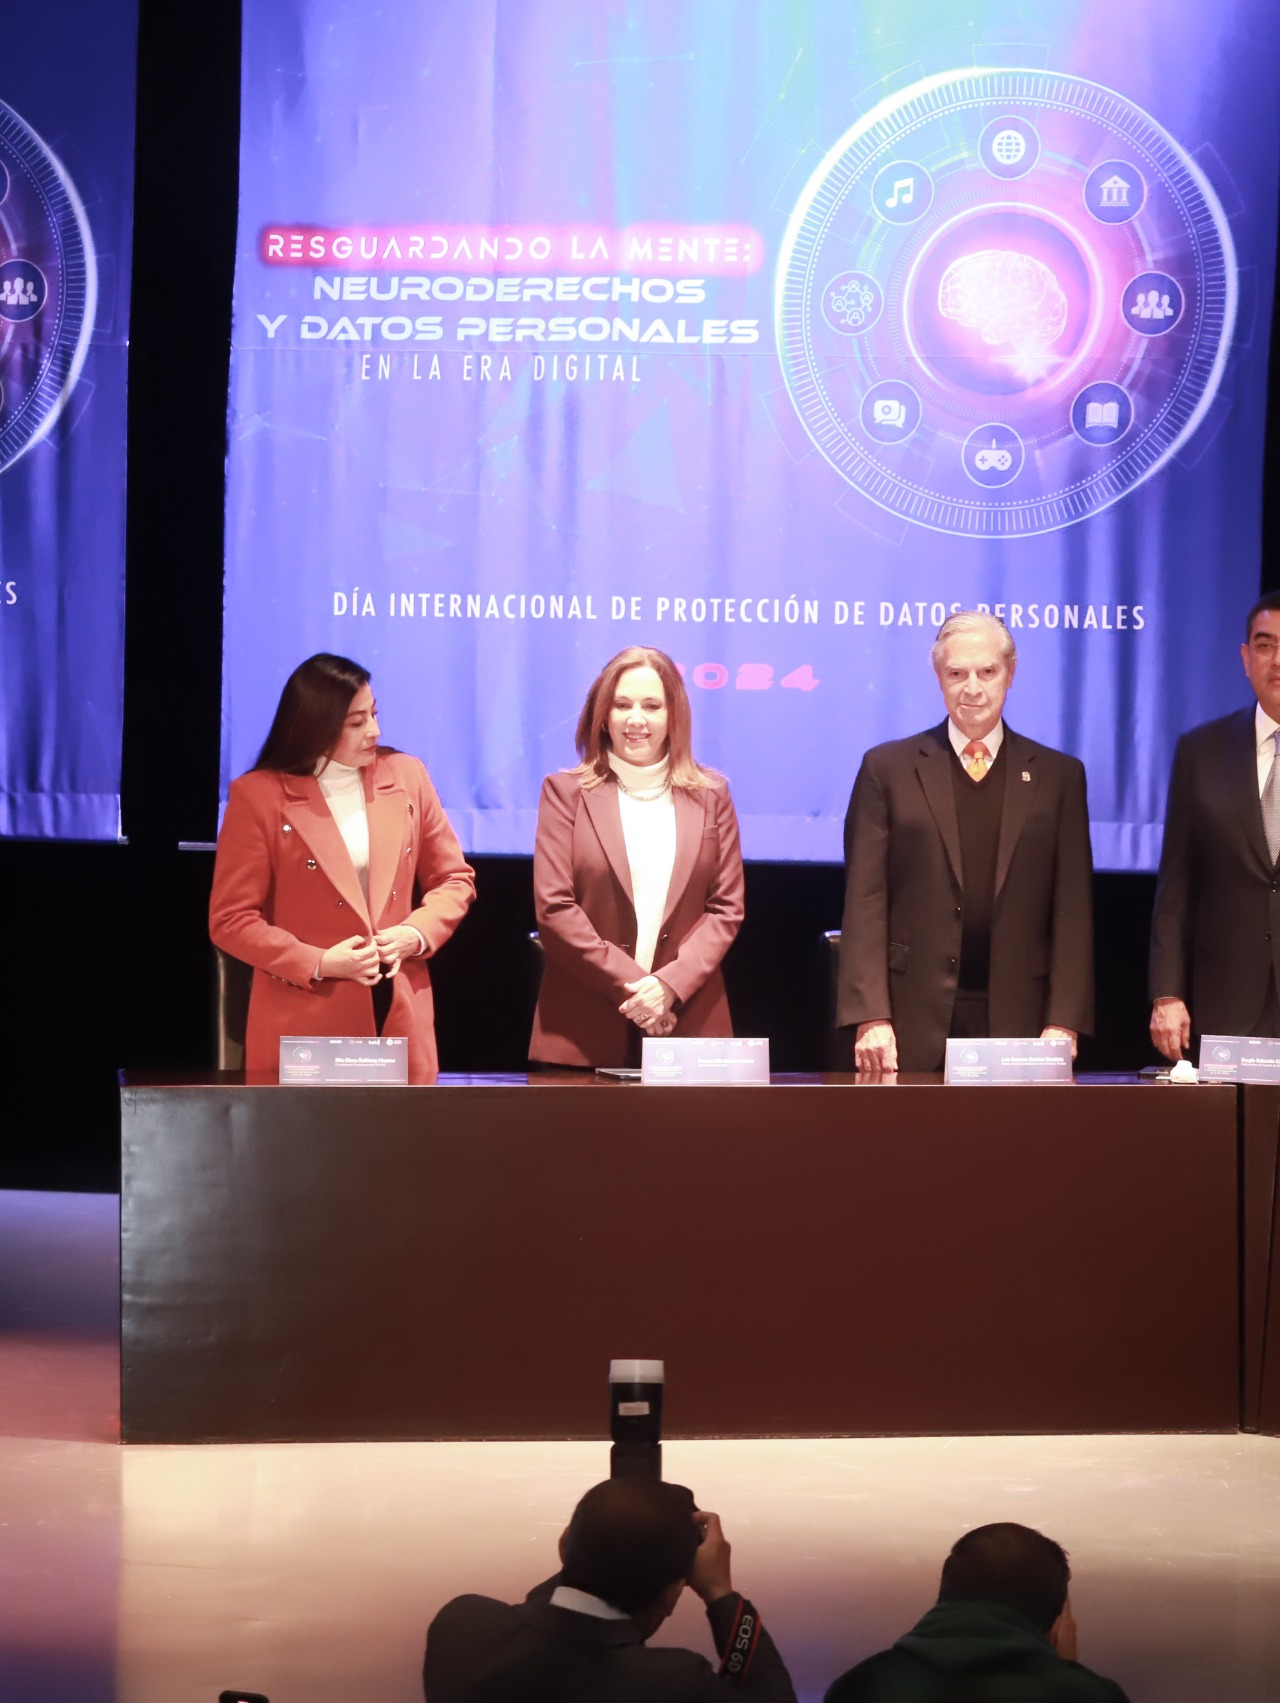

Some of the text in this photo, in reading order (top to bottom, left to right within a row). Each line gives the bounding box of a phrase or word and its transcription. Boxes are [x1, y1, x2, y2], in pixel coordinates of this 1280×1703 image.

[268, 234, 753, 263] RESGUARDANDO LA MENTE:
[313, 275, 706, 304] NEURODERECHOS
[256, 314, 760, 345] Y DATOS PERSONALES
[361, 353, 642, 382] EN LA ERA DIGITAL
[333, 586, 376, 617] DÍA
[389, 592, 597, 620] INTERNACIONAL
[611, 595, 642, 621] DE
[656, 593, 819, 624] PROTECCIÓN
[834, 599, 865, 626] DE
[675, 662, 821, 692] 024
[736, 1614, 754, 1651] EOS
